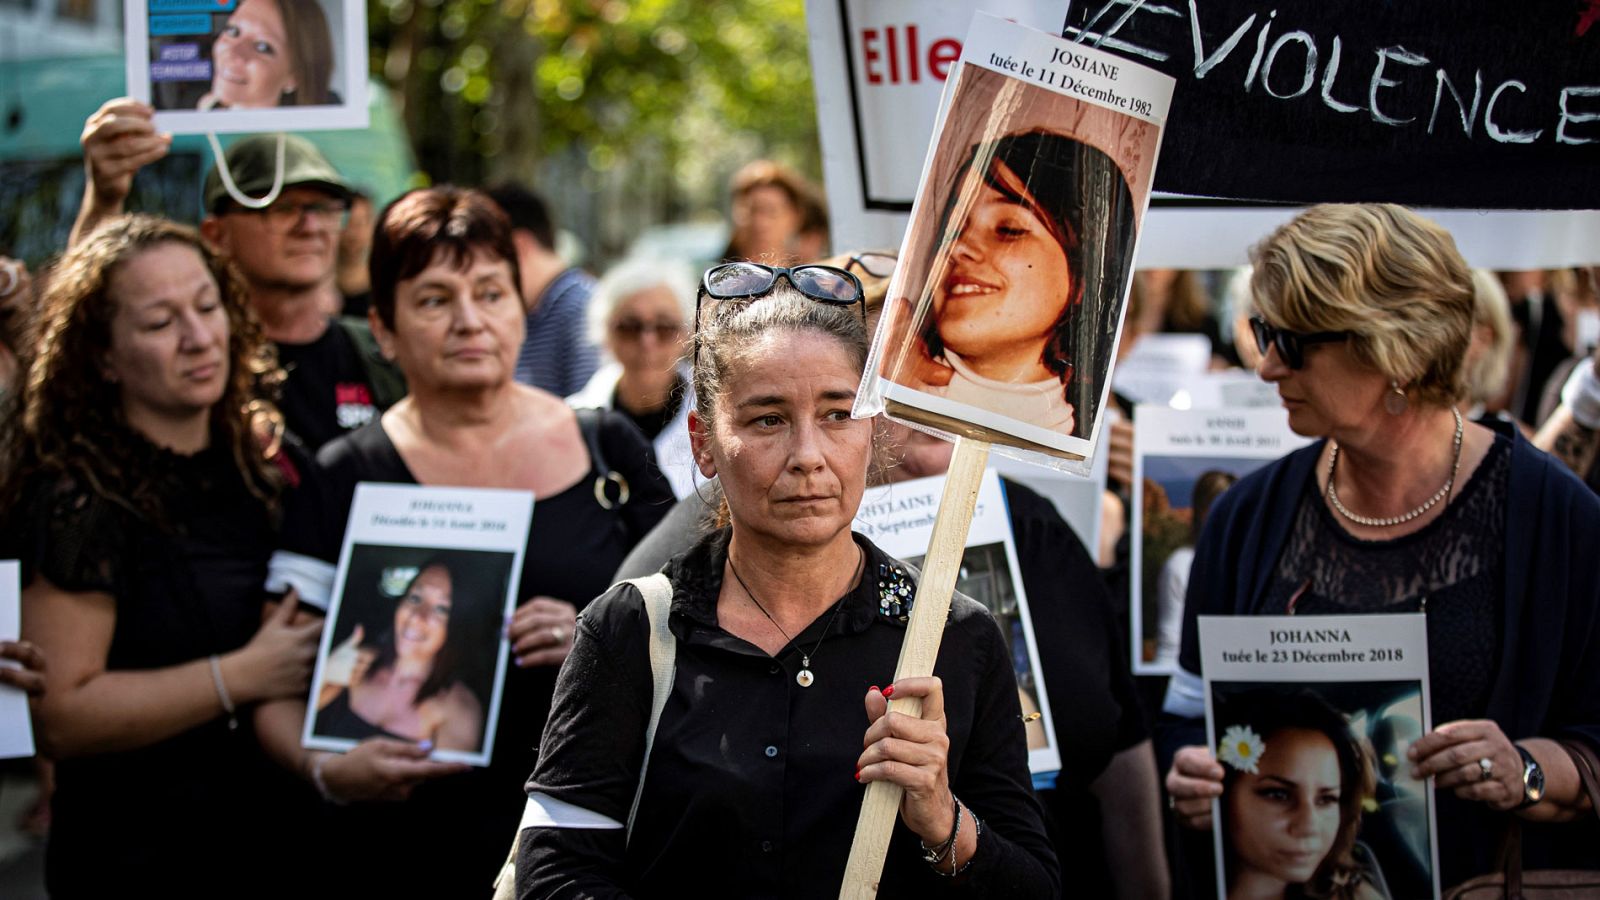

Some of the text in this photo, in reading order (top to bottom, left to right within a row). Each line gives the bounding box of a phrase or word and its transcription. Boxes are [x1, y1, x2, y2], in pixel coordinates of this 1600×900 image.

[861, 24, 962, 85] Elle
[1049, 47, 1120, 82] JOSIANE
[989, 52, 1153, 117] tuée le 11 Décembre 1982
[861, 495, 934, 517] HYLAINE
[1270, 629, 1352, 645] JOHANNA
[1222, 648, 1404, 664] tuée le 23 Décembre 2018
